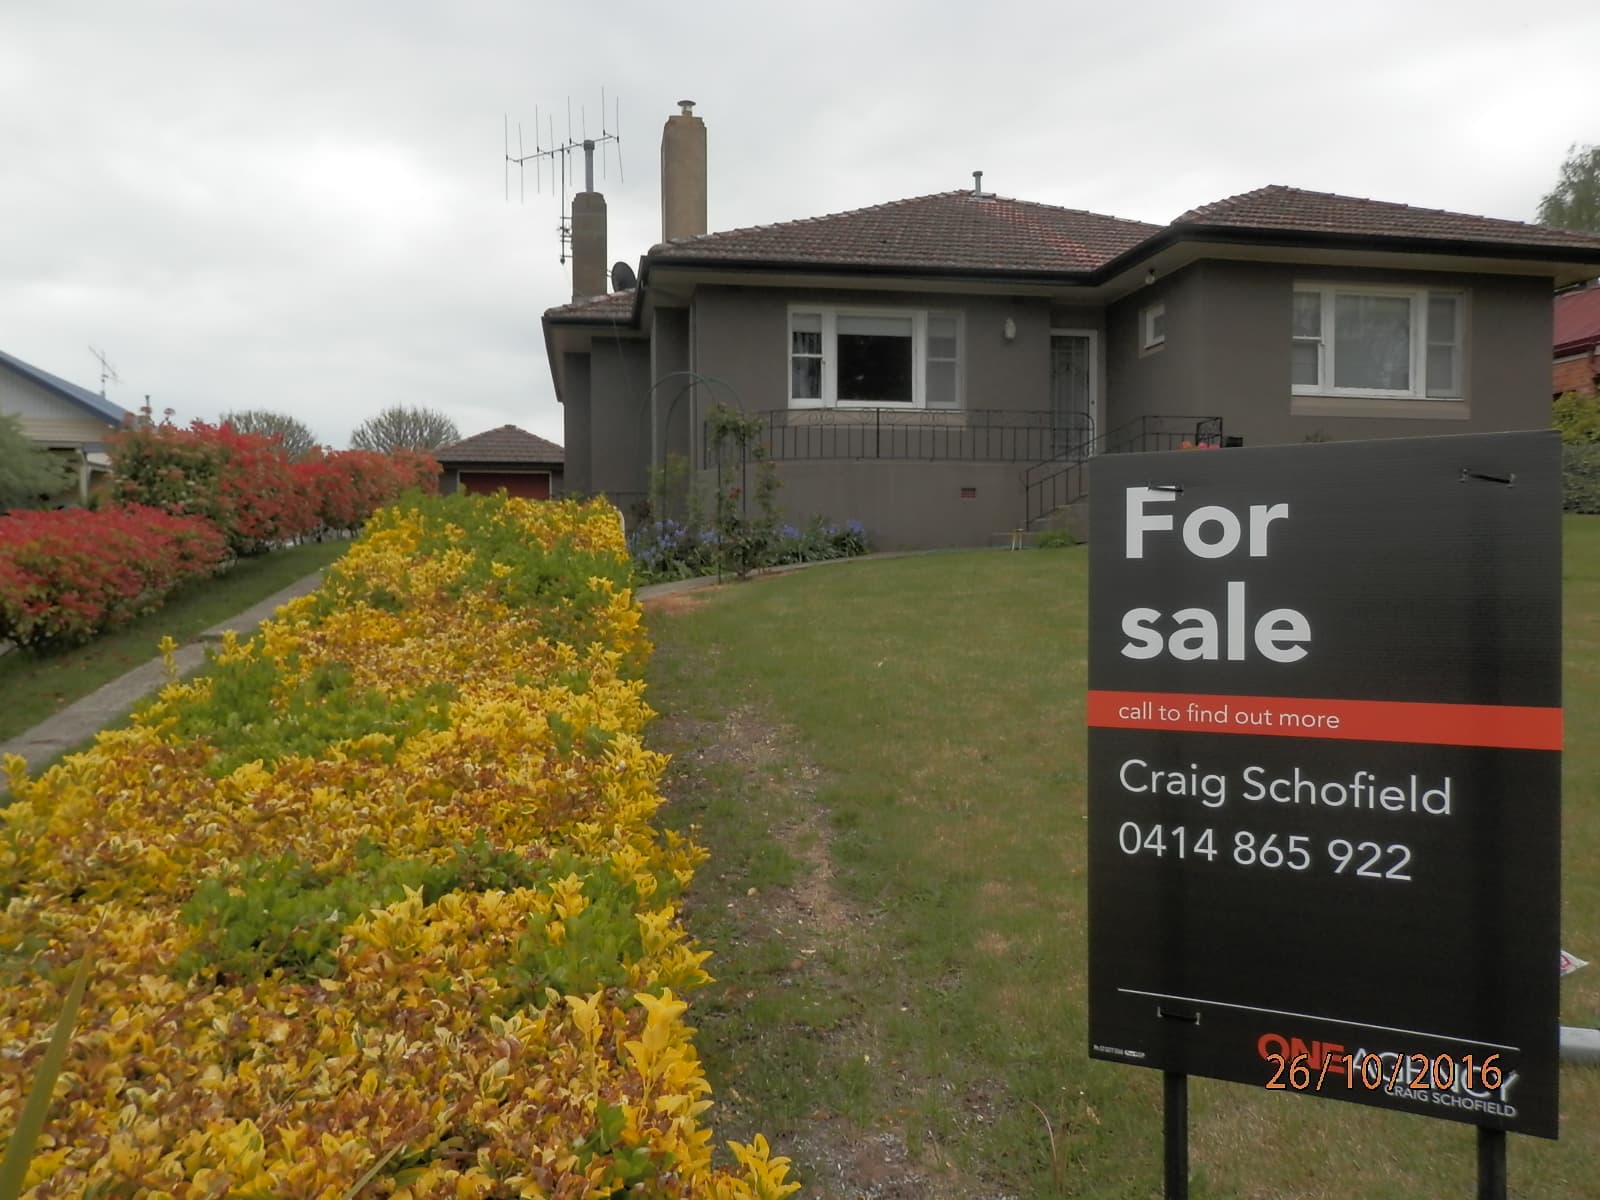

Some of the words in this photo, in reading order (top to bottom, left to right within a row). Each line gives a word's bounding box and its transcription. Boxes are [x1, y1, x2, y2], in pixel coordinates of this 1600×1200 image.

[1125, 485, 1290, 560] For
[1119, 580, 1312, 664] sale
[1118, 701, 1152, 720] call
[1158, 705, 1181, 722] to
[1187, 703, 1229, 724] find
[1234, 709, 1273, 726] out
[1279, 713, 1341, 729] more
[1118, 757, 1226, 808] Craig
[1241, 765, 1453, 816] Schofield
[1118, 821, 1218, 862] 0414
[1232, 830, 1311, 871] 865
[1326, 838, 1413, 882] 922
[1384, 1085, 1430, 1103] CRAIG
[1432, 1093, 1519, 1119] SCHOFIELD
